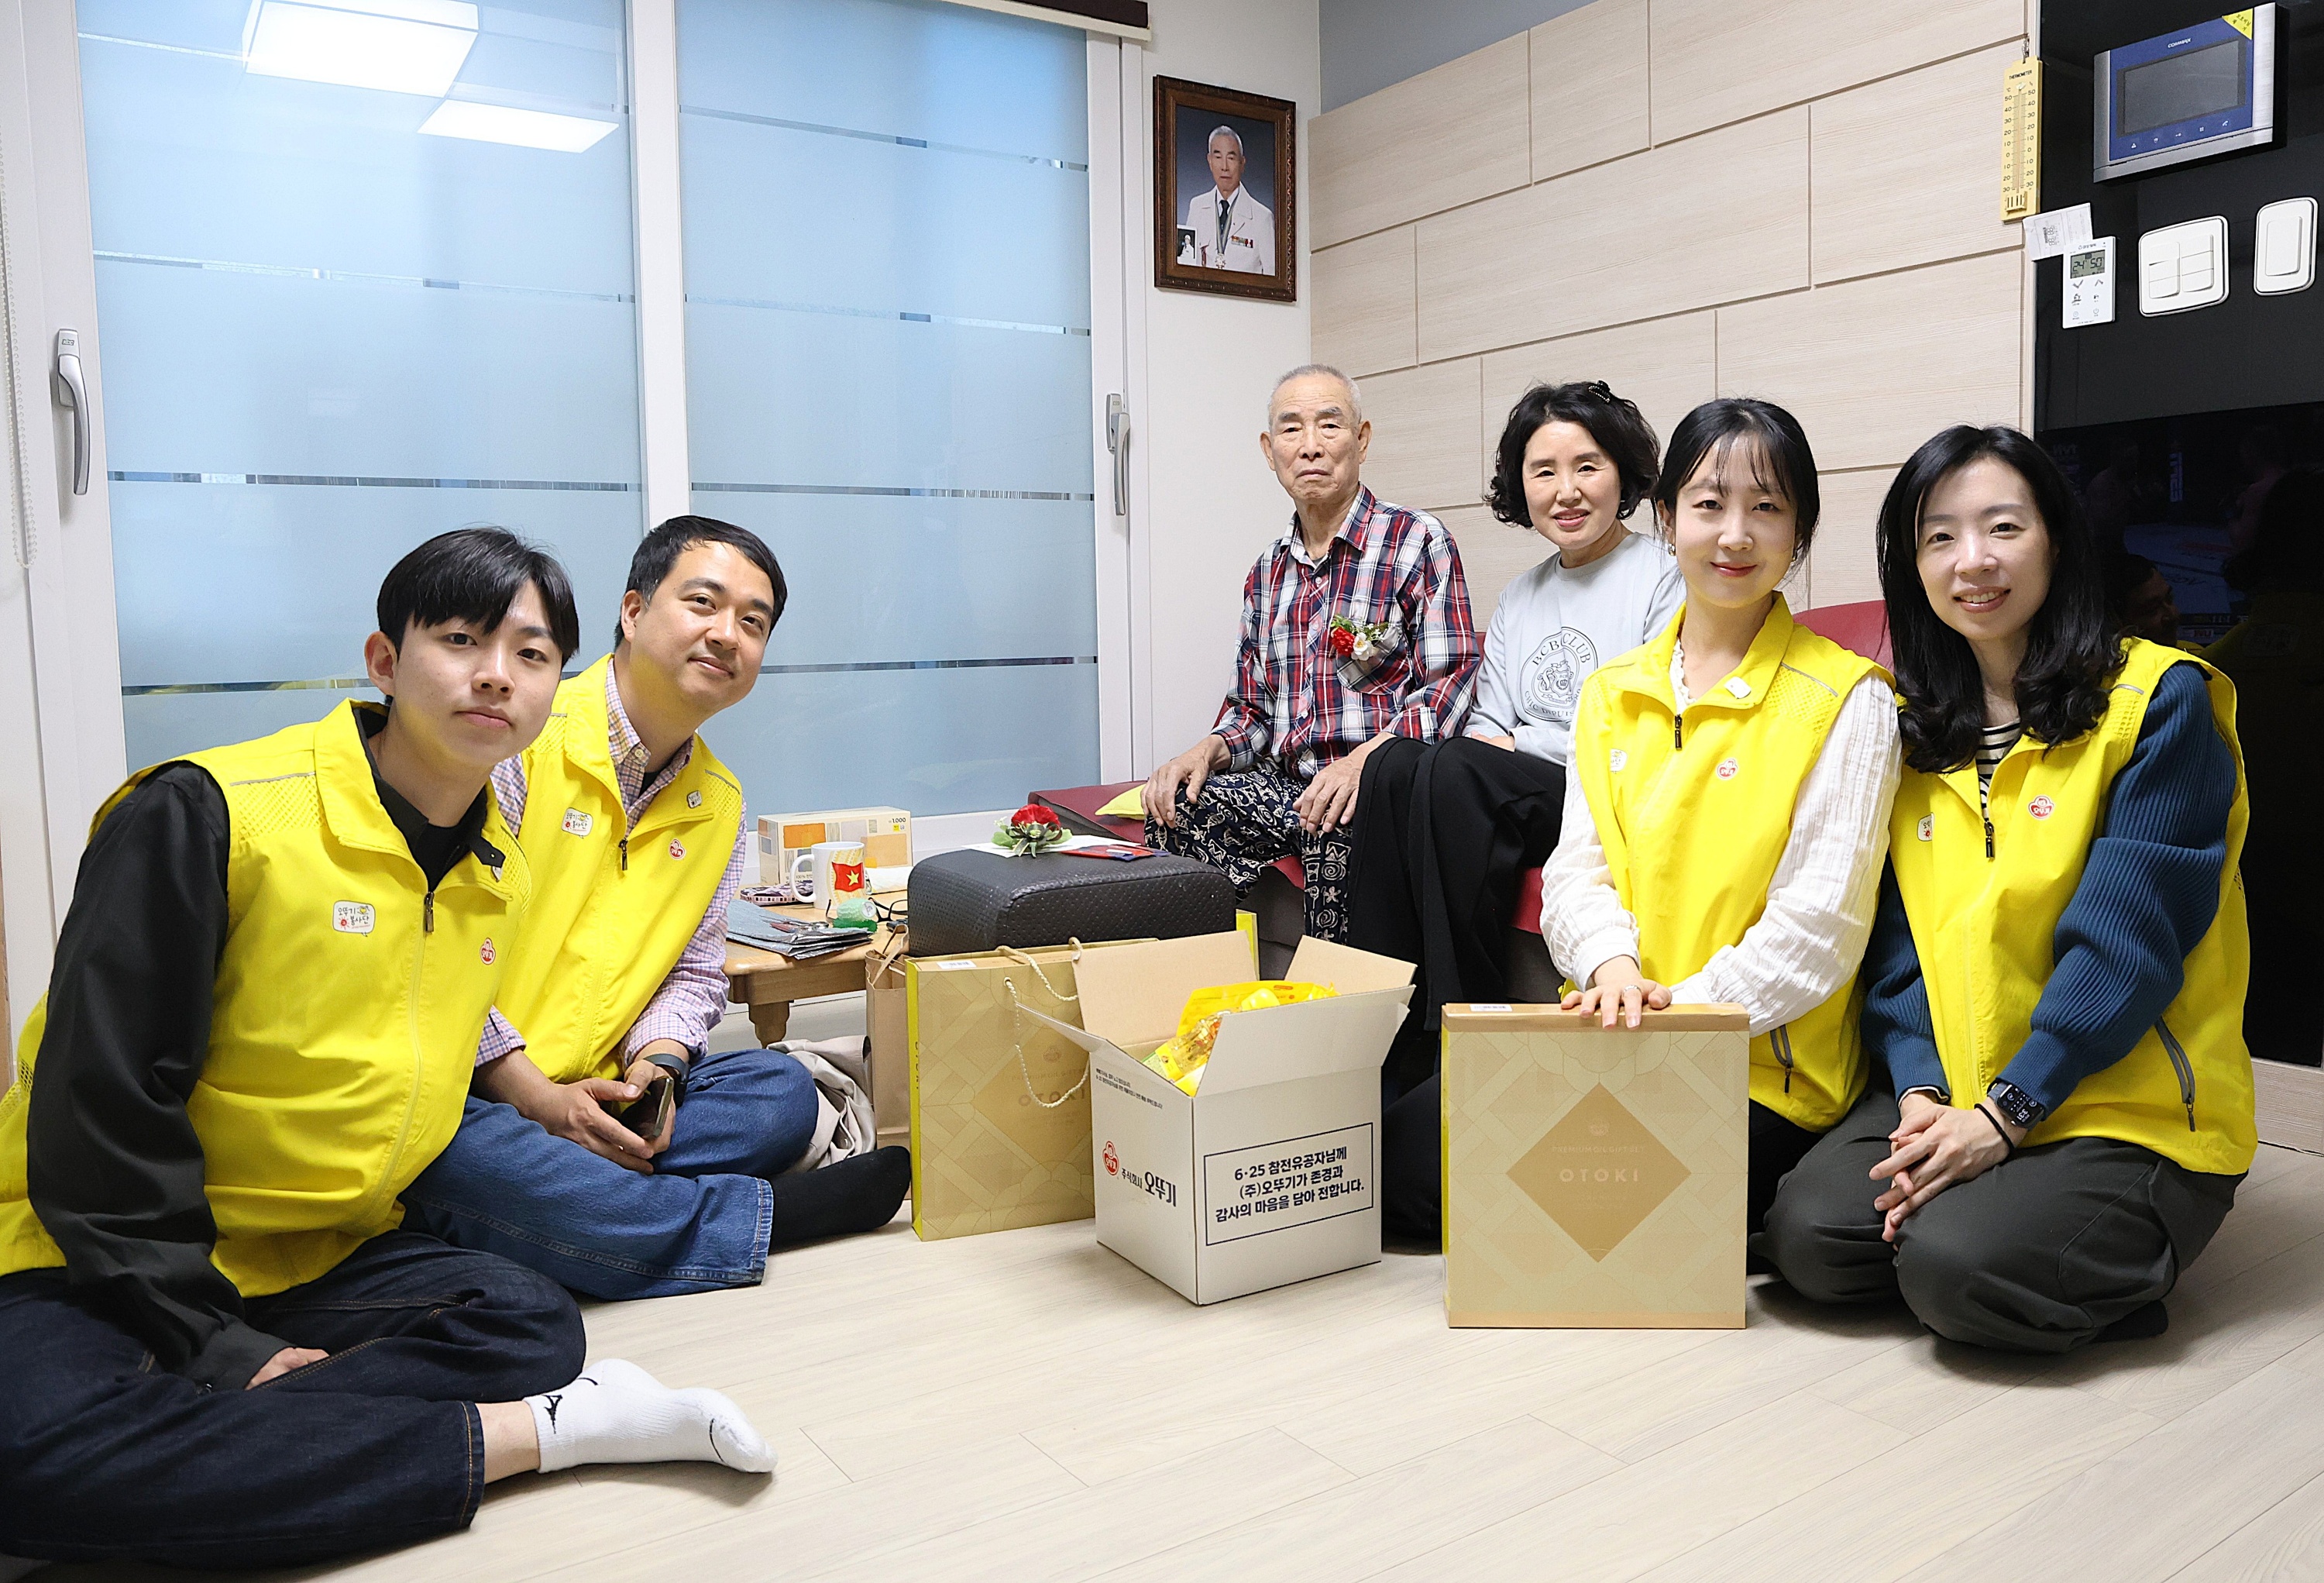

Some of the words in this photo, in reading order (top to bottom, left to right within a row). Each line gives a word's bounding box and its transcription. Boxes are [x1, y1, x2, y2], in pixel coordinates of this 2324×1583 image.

[2009, 70, 2032, 80] THERMOMETER
[1532, 640, 1559, 666] BCB
[1563, 632, 1591, 663] CLUB
[1525, 690, 1538, 711] CHIC
[339, 907, 356, 916] 오뚜기
[350, 915, 370, 926] 봉사단
[1269, 1146, 1346, 1175] 참전유공자님께
[1122, 1168, 1142, 1189] 주식회사
[1144, 1172, 1176, 1207] 오뚜기
[1239, 1173, 1308, 1199] (주)오뚜기가
[1311, 1165, 1343, 1185] 존경과
[1559, 1168, 1638, 1182] OTOKI
[1215, 1203, 1251, 1223] 감사의
[1255, 1196, 1289, 1213] 마음을
[1293, 1189, 1315, 1206] 담아
[1318, 1179, 1364, 1201] 전합니다.
